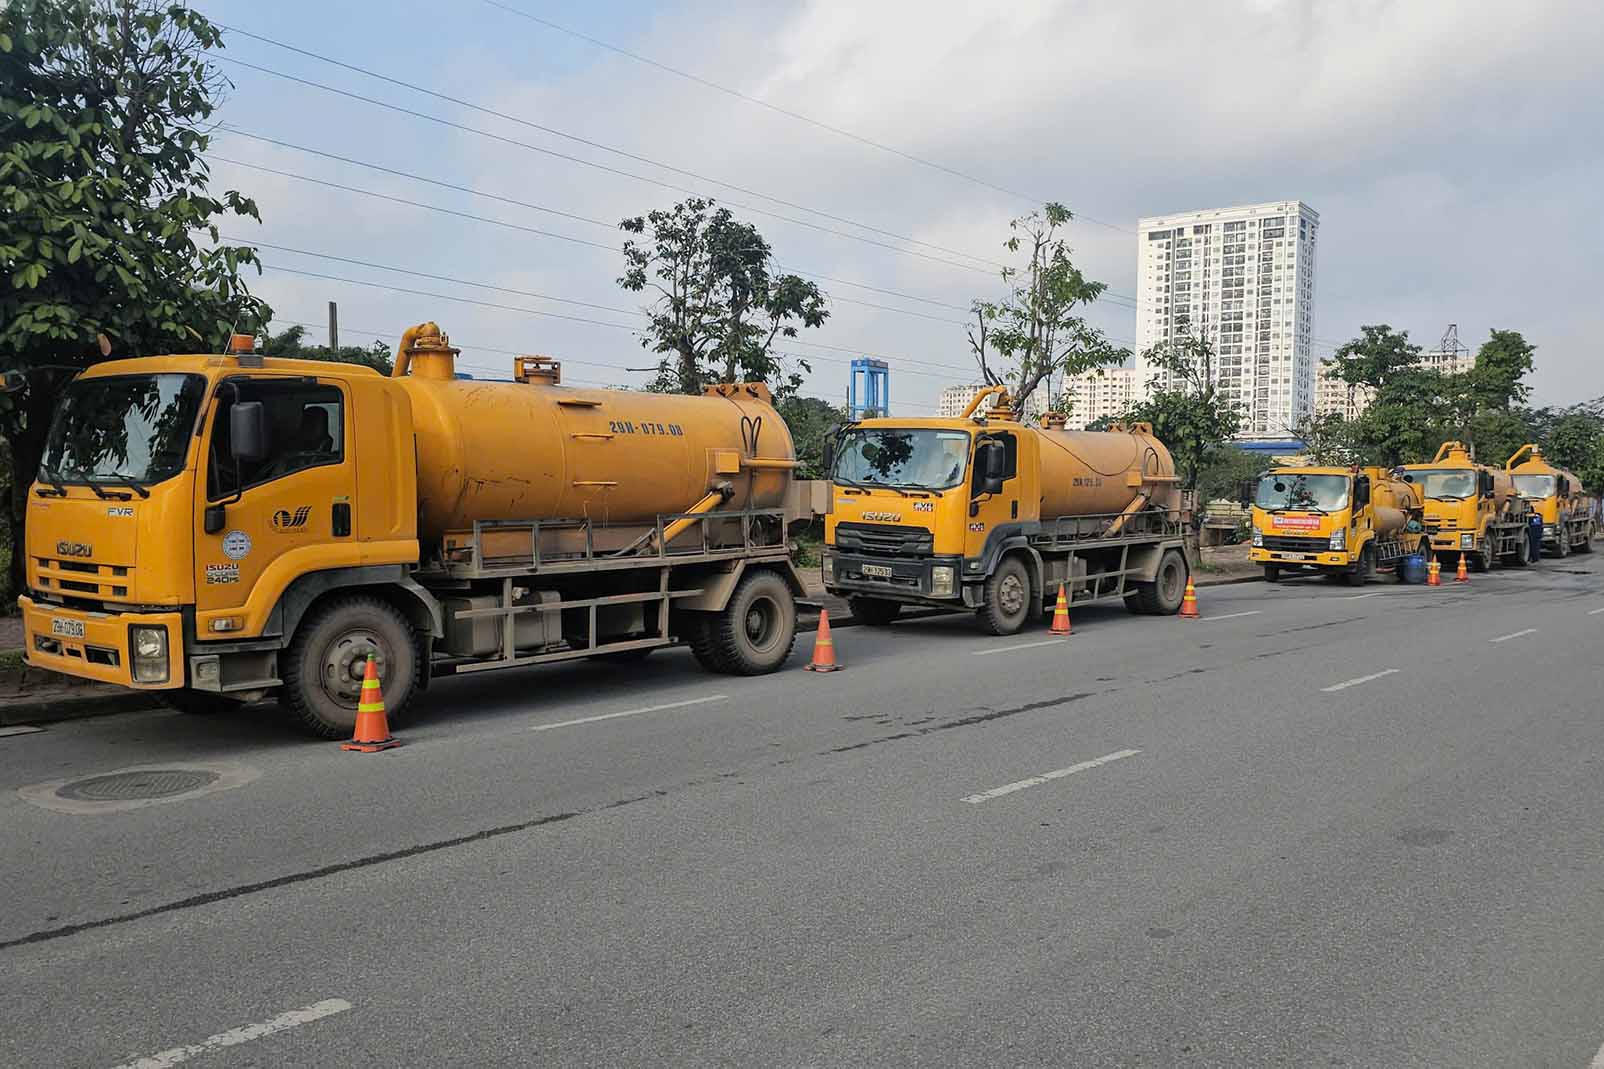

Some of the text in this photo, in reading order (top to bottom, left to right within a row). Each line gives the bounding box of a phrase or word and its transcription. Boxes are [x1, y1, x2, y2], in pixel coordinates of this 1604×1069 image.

[107, 507, 134, 517] FVR
[862, 511, 902, 522] ISUZU
[56, 541, 92, 558] ISUZU
[206, 563, 239, 571] ISUZU
